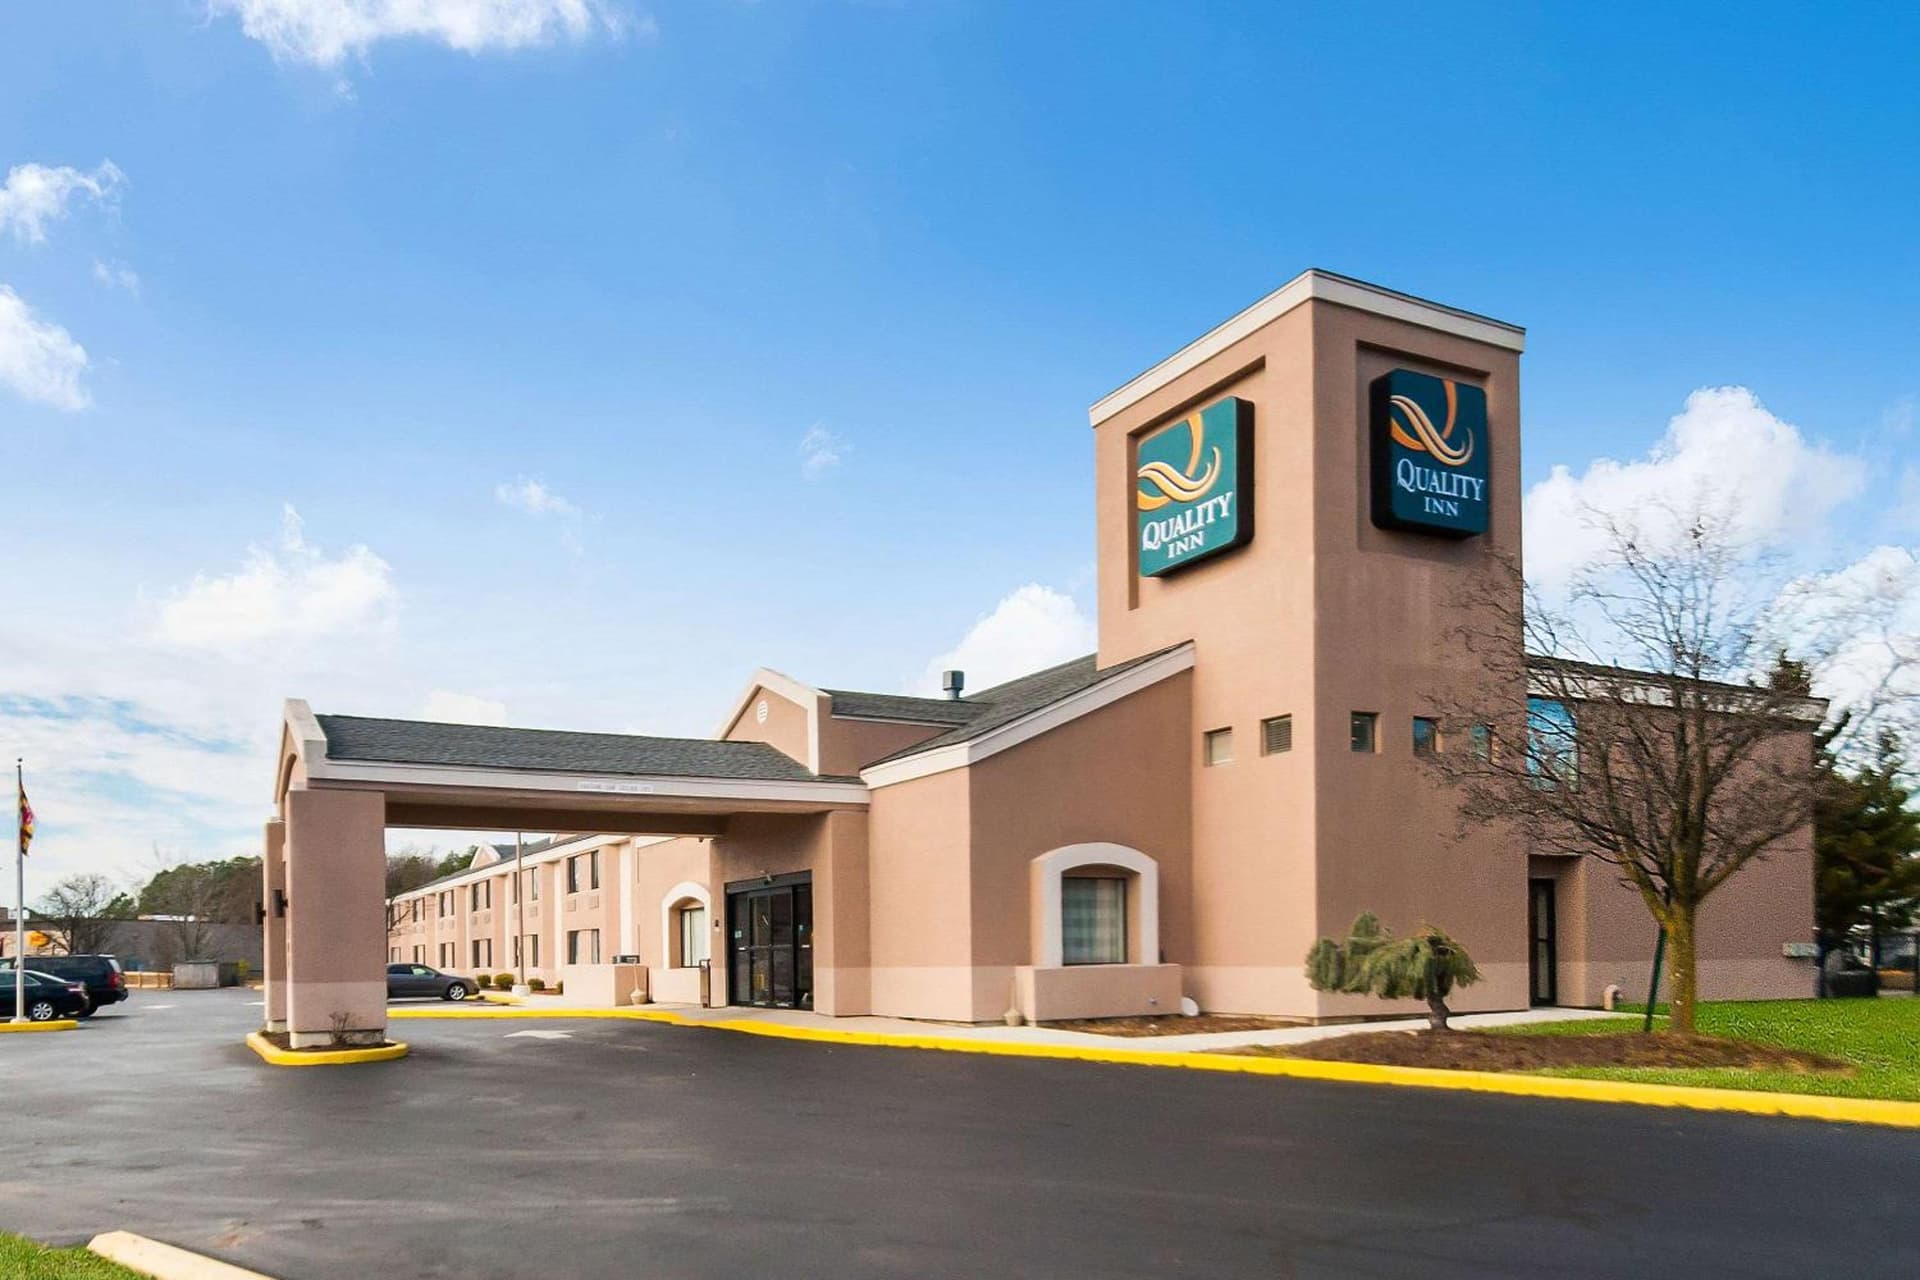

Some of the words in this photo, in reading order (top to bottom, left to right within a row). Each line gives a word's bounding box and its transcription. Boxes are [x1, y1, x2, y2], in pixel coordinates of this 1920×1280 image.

[1396, 458, 1484, 501] QUALITY
[1142, 491, 1232, 551] QUALITY
[1423, 496, 1459, 517] INN
[1167, 531, 1204, 558] INN
